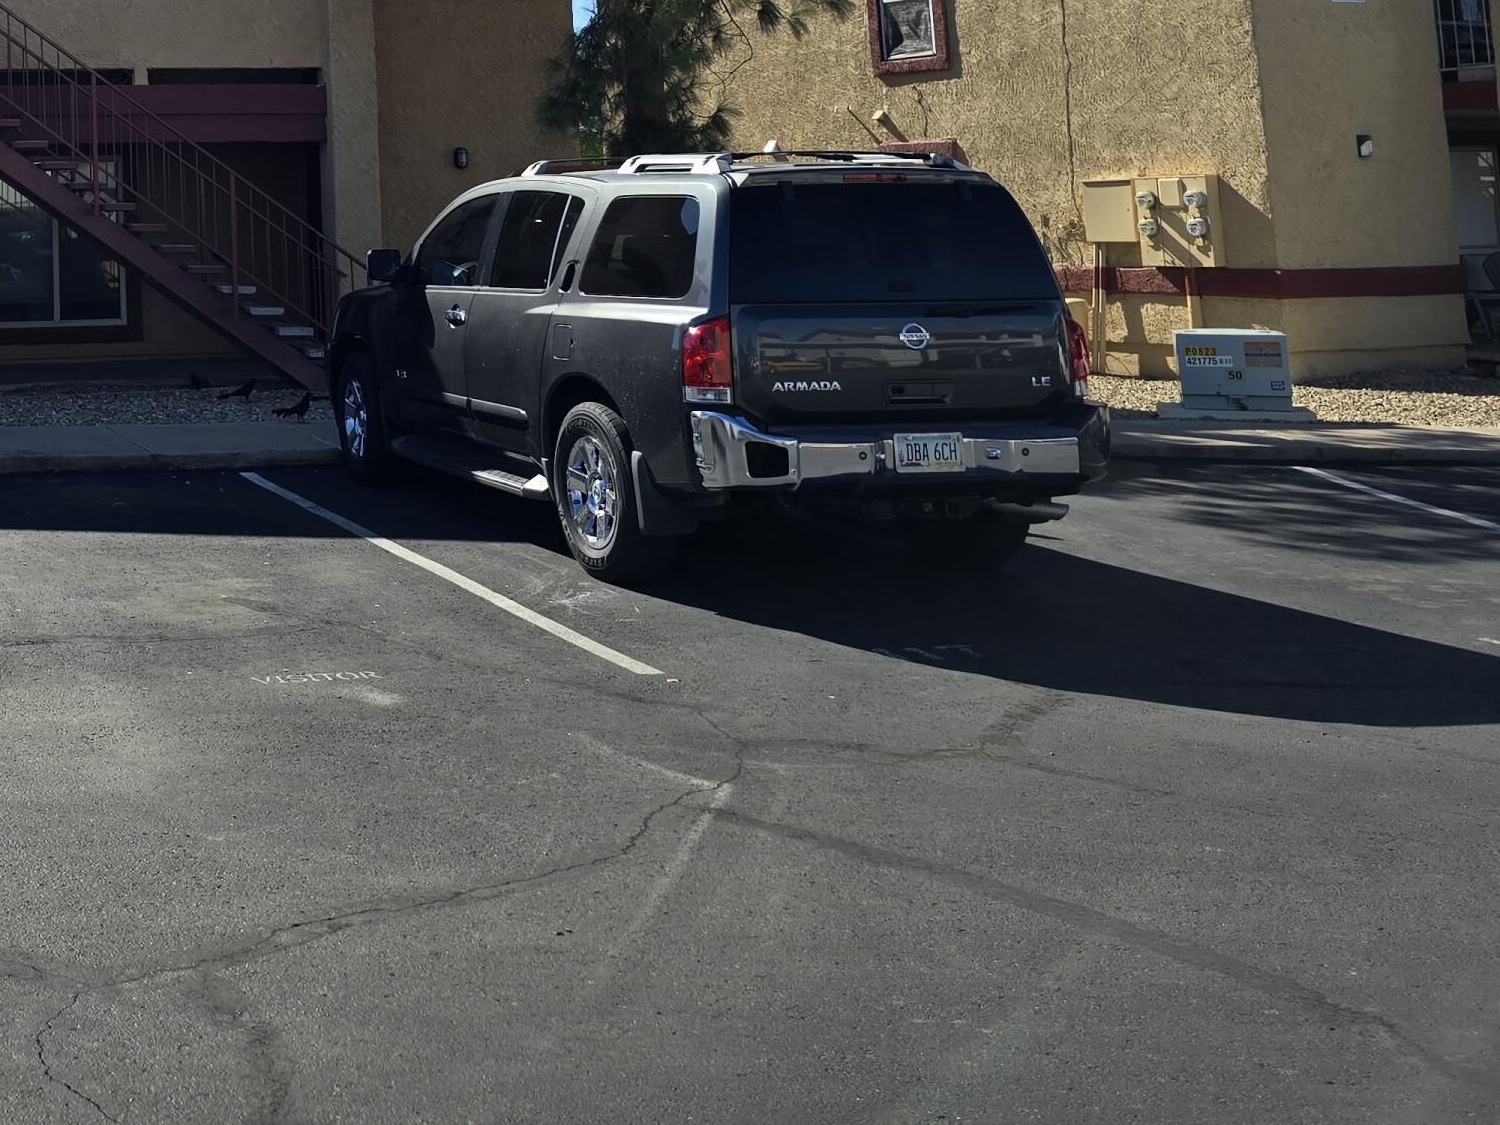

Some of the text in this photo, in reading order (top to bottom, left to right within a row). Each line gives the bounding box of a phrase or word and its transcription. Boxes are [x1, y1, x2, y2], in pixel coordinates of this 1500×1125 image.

[1186, 356, 1218, 366] 421775
[1228, 370, 1243, 380] 50
[1031, 376, 1051, 386] LE
[771, 381, 842, 392] ARMADA
[906, 443, 958, 461] DBA 6CH
[249, 670, 385, 685] VISITOR
